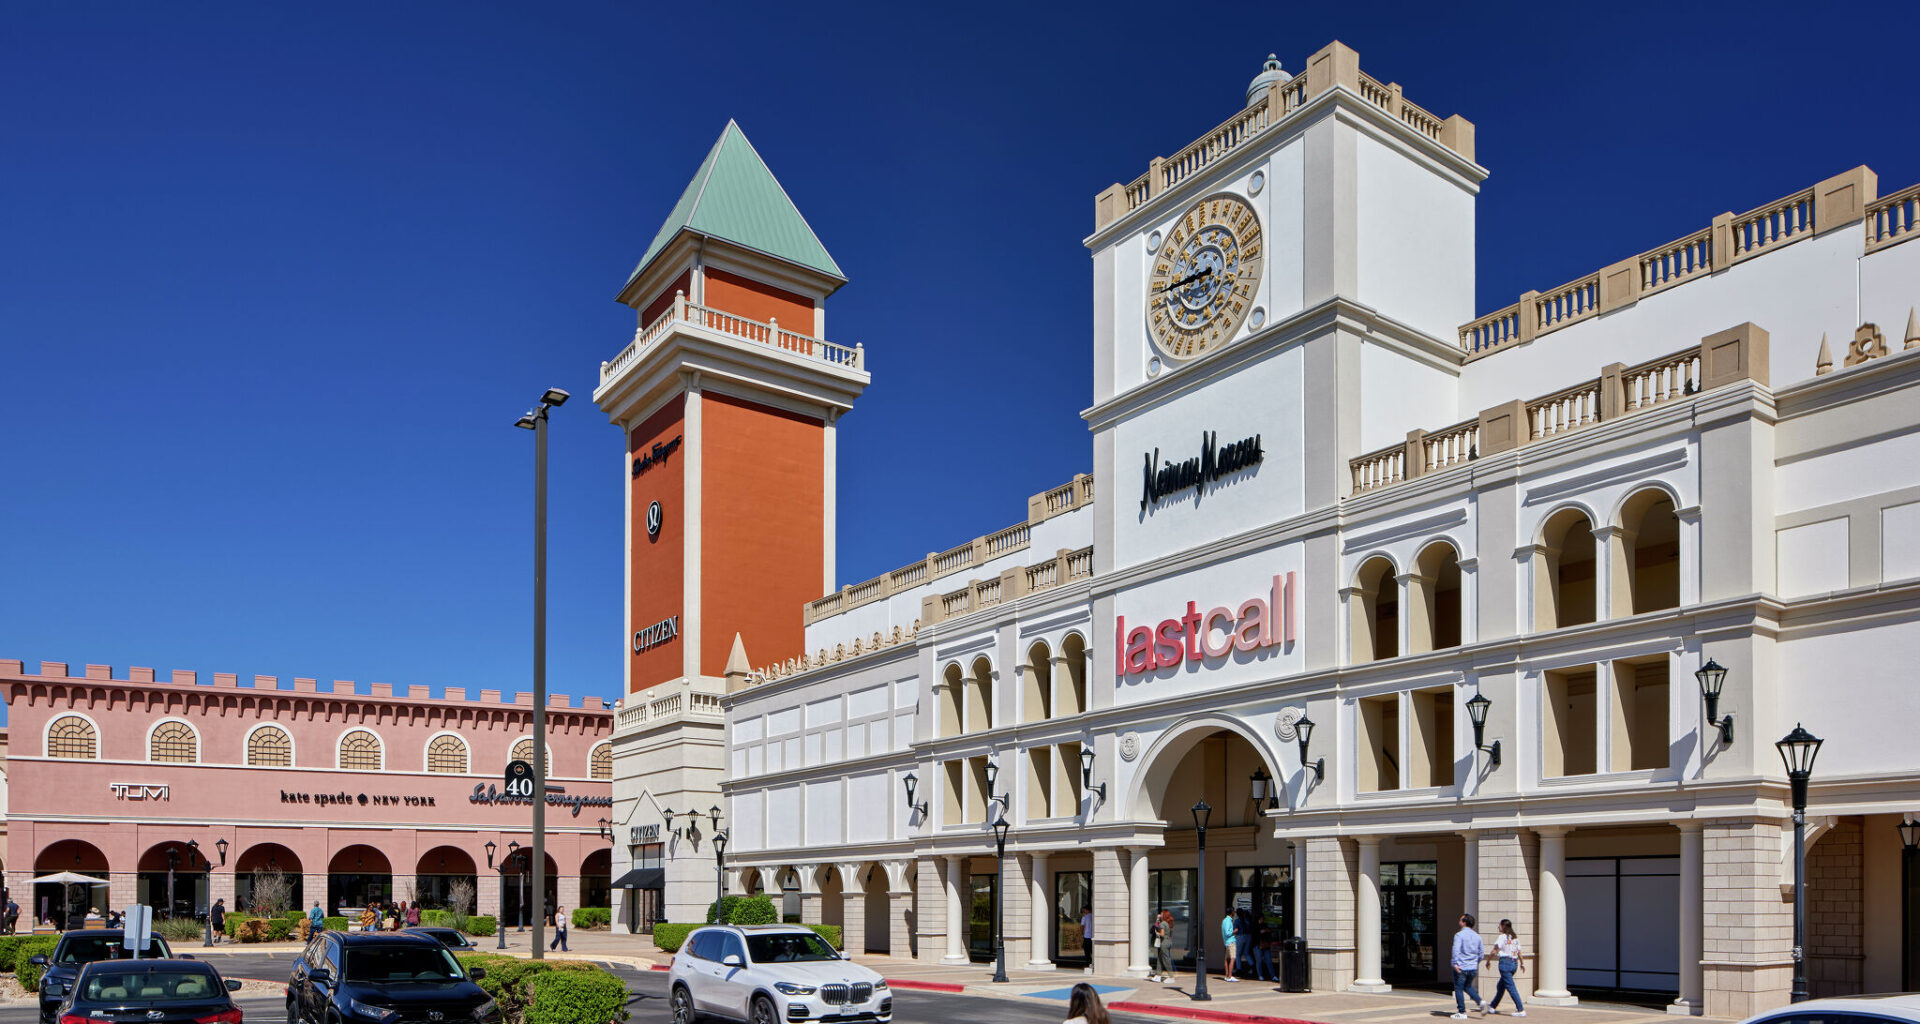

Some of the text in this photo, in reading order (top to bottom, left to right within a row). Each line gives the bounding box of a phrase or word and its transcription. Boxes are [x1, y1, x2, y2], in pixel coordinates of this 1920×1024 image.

[1140, 430, 1266, 511] Neiman Marcus
[633, 615, 679, 651] CITIZEN
[109, 782, 169, 799] TUMI
[505, 778, 534, 796] 40
[280, 789, 436, 807] kate spade NEW YORK
[630, 824, 661, 840] CITIZEN
